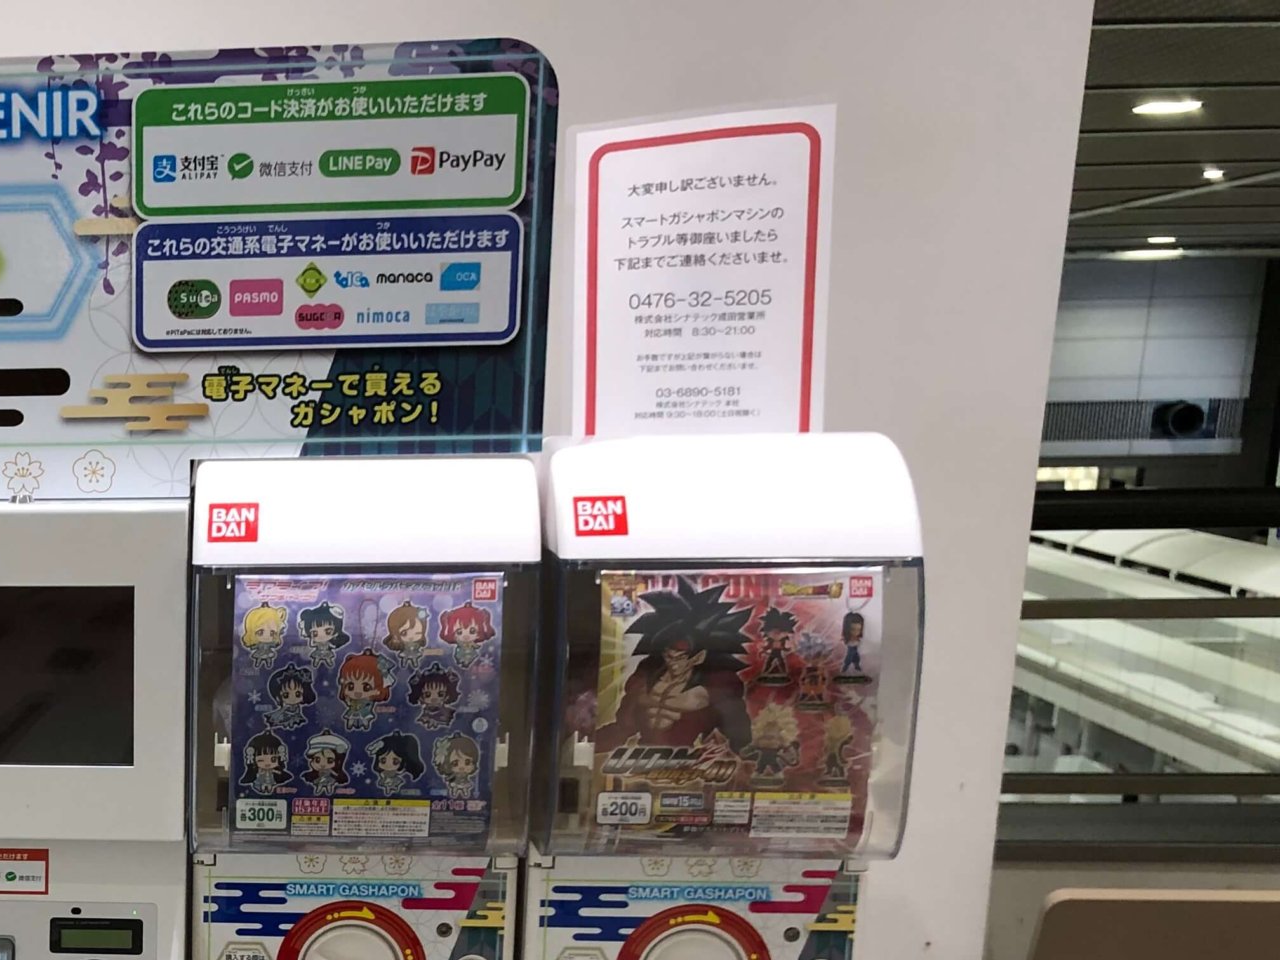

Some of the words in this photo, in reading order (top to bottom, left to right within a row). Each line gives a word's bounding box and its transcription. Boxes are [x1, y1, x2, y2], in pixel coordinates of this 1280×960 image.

[171, 92, 487, 122] これらのコード決済がお使いいただけます
[180, 155, 219, 172] 支付宝
[259, 161, 313, 178] 微信支付
[329, 156, 363, 171] LINE
[365, 155, 393, 173] Pay
[439, 150, 506, 172] PayPay
[181, 172, 218, 181] ALIPAY
[627, 173, 777, 198] 大変申し訳ございません。
[621, 206, 784, 230] スマートガシャポンマシンの
[147, 228, 510, 257] これらの交通系電子マネーがお使いいただけます
[627, 228, 778, 250] トラブル等御座いましたら
[614, 251, 788, 272] 下記までご連絡くださいませ。
[376, 271, 433, 285] manaca
[234, 292, 279, 304] PASMO
[628, 288, 772, 310] 0476-32-5205
[356, 308, 411, 324] nimoca
[204, 371, 442, 399] 電子マネーで買える
[286, 884, 335, 896] SMART
[339, 884, 420, 898] GASHAPON
[628, 886, 680, 899] SMART
[684, 887, 768, 900] GASHAPON
